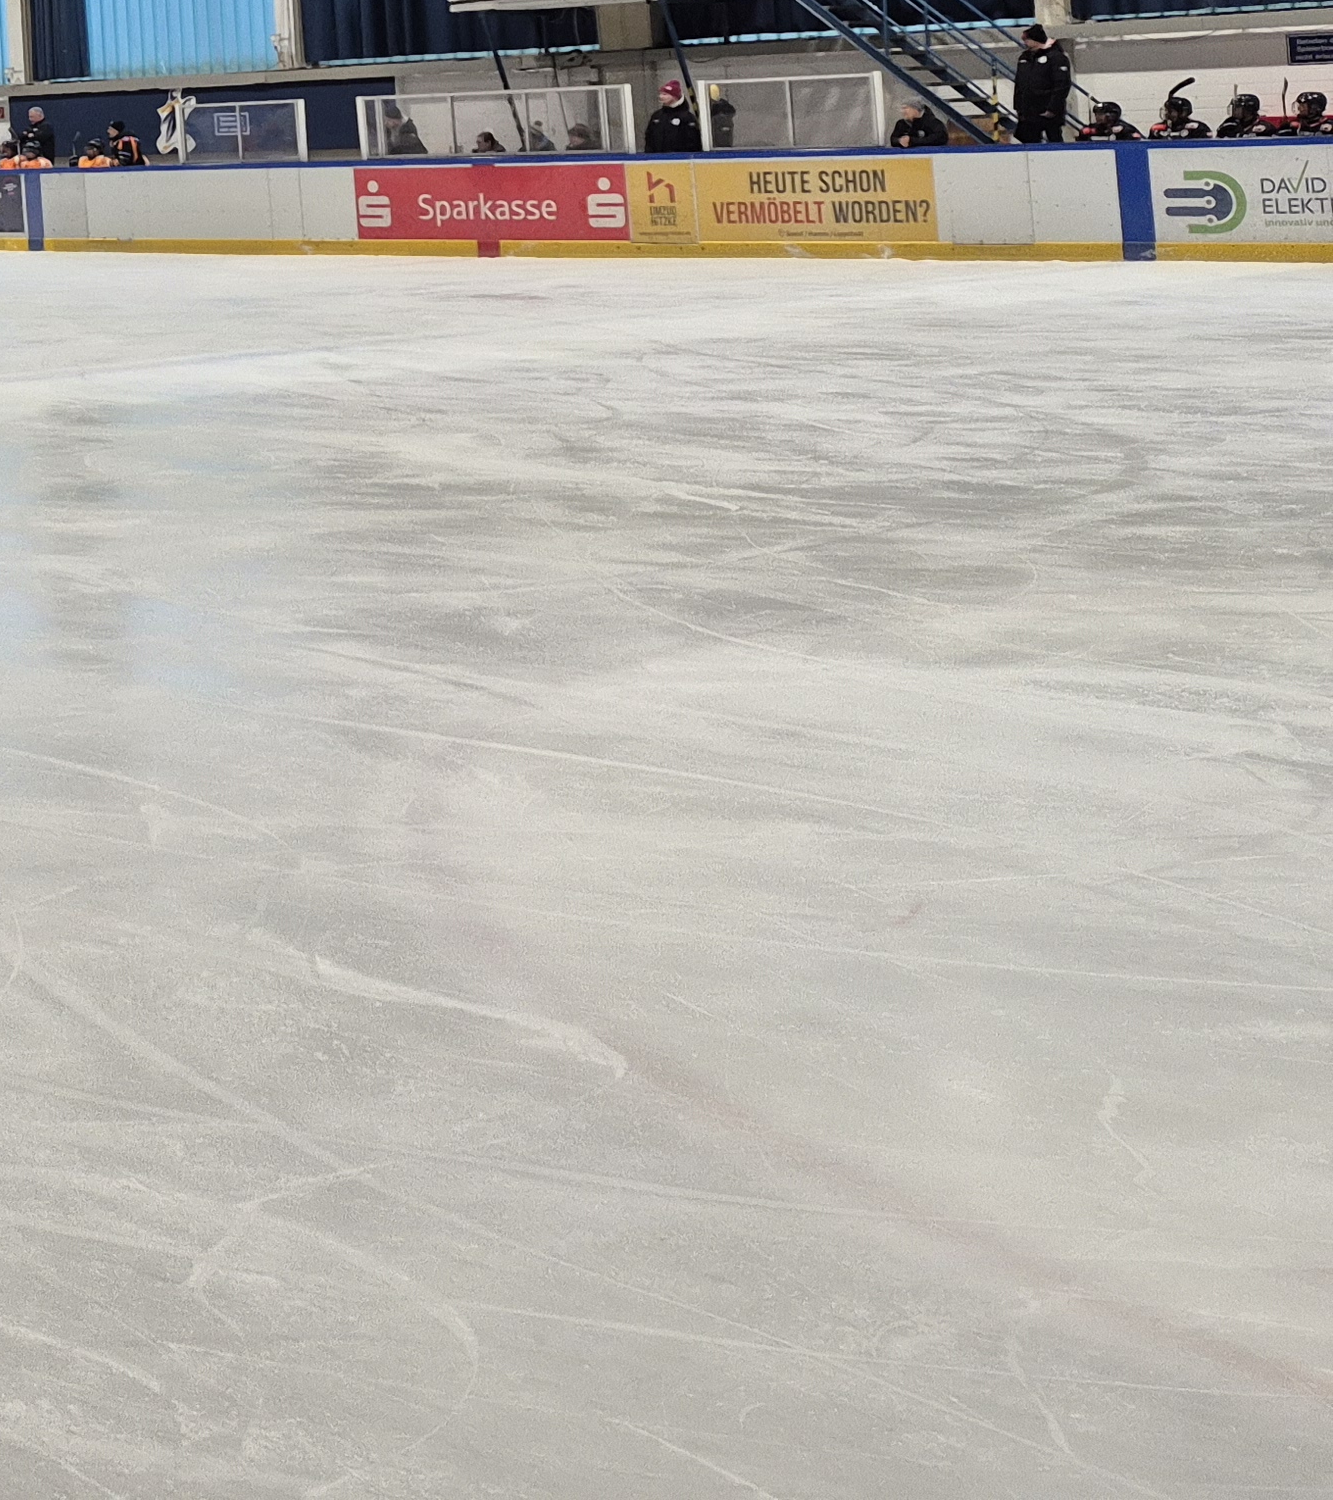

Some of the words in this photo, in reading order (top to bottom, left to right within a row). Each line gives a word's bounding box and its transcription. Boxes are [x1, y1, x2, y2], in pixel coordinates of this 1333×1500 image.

[749, 170, 812, 194] HEUTE
[818, 169, 887, 193] SCHON
[1260, 160, 1327, 194] DAVID
[417, 193, 558, 228] Sparkasse
[712, 197, 825, 224] VERMÖBELT
[831, 199, 931, 224] WORDEN?
[1262, 197, 1333, 215] ELEKT
[1264, 218, 1313, 228] innovativ
